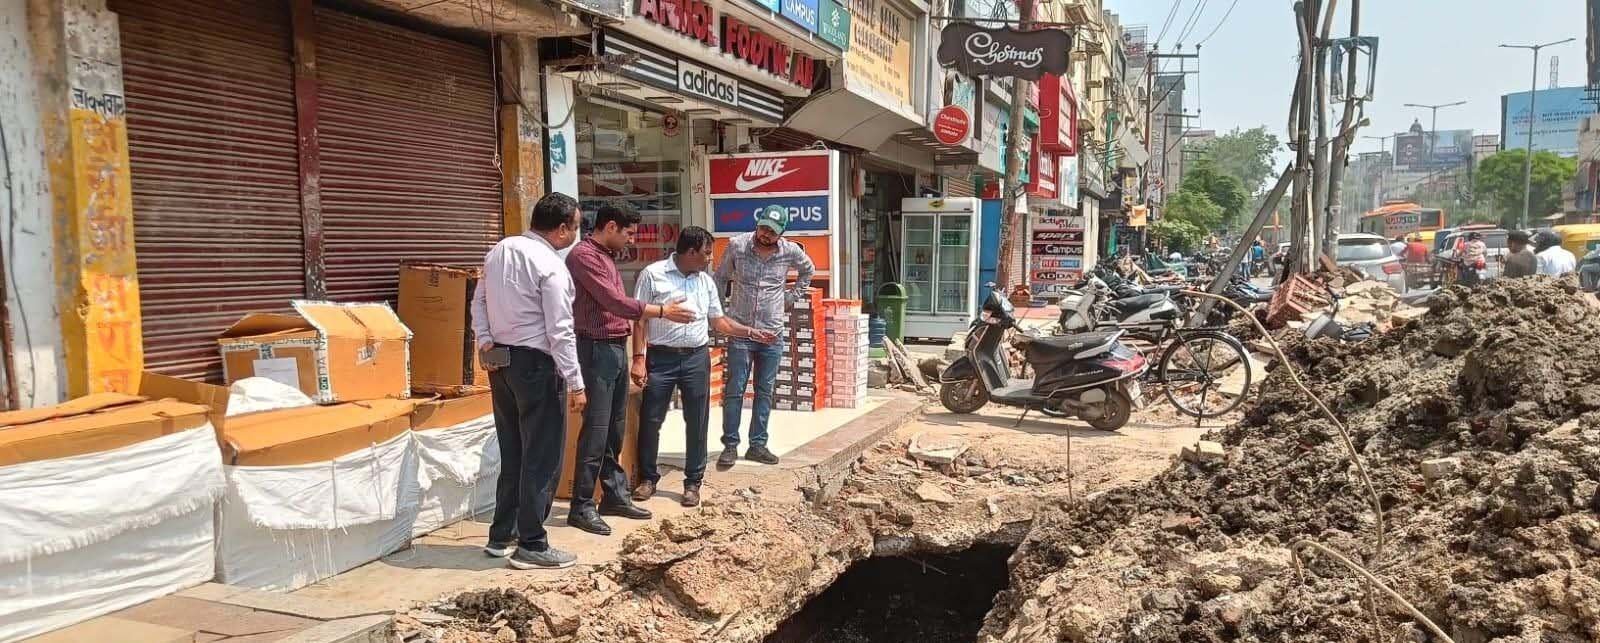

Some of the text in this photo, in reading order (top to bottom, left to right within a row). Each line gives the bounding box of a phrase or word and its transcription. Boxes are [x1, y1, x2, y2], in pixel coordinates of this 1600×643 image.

[965, 31, 1043, 68] Chestnuts
[683, 69, 734, 103] adidas
[744, 158, 788, 176] NIKE
[753, 206, 823, 222] CPUS
[1045, 244, 1082, 254] Campus
